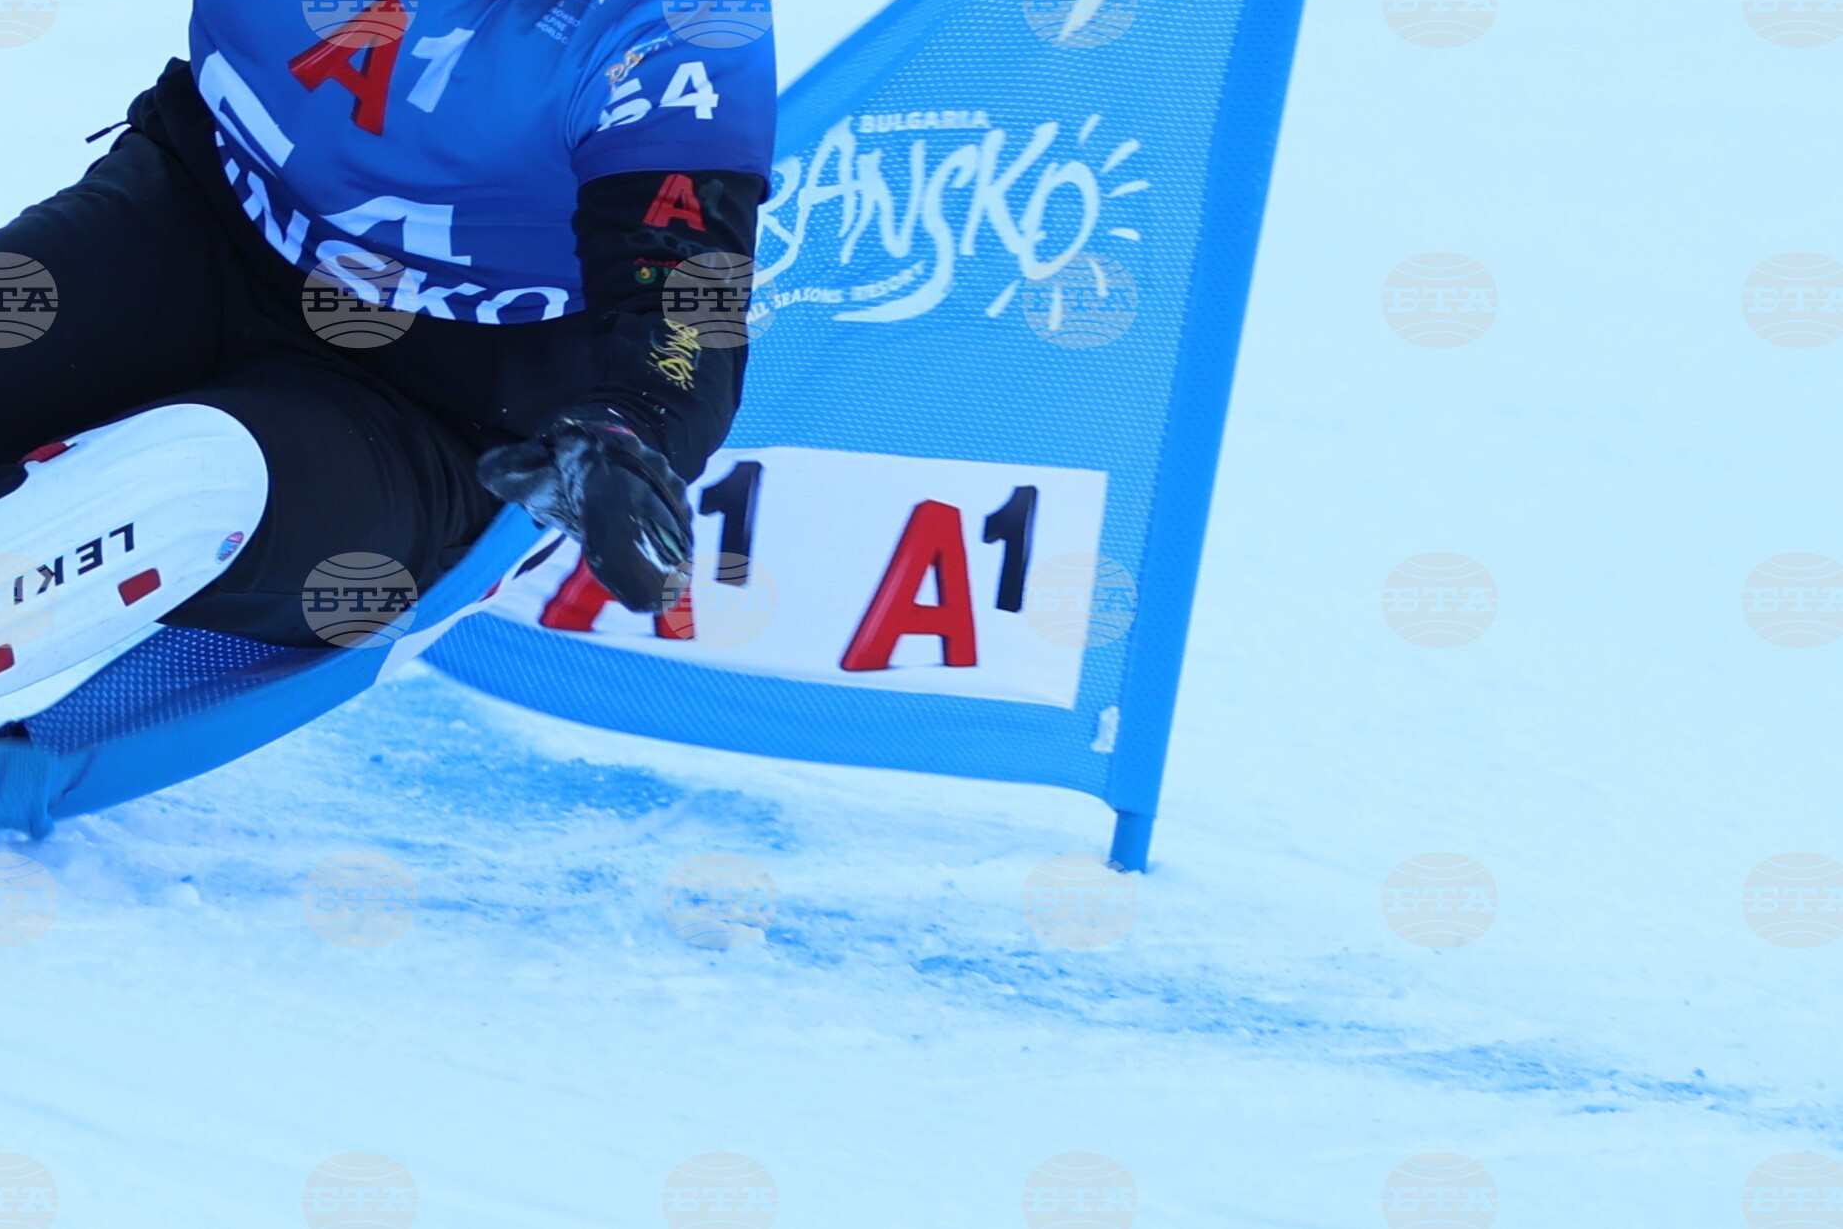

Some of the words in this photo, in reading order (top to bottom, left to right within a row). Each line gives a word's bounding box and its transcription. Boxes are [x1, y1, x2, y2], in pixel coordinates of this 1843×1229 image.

[858, 111, 991, 132] BULGARIA
[754, 115, 1101, 322] BANSKO
[773, 287, 846, 309] SEASONS
[13, 522, 135, 605] LEKI
[840, 485, 1039, 672] A1
